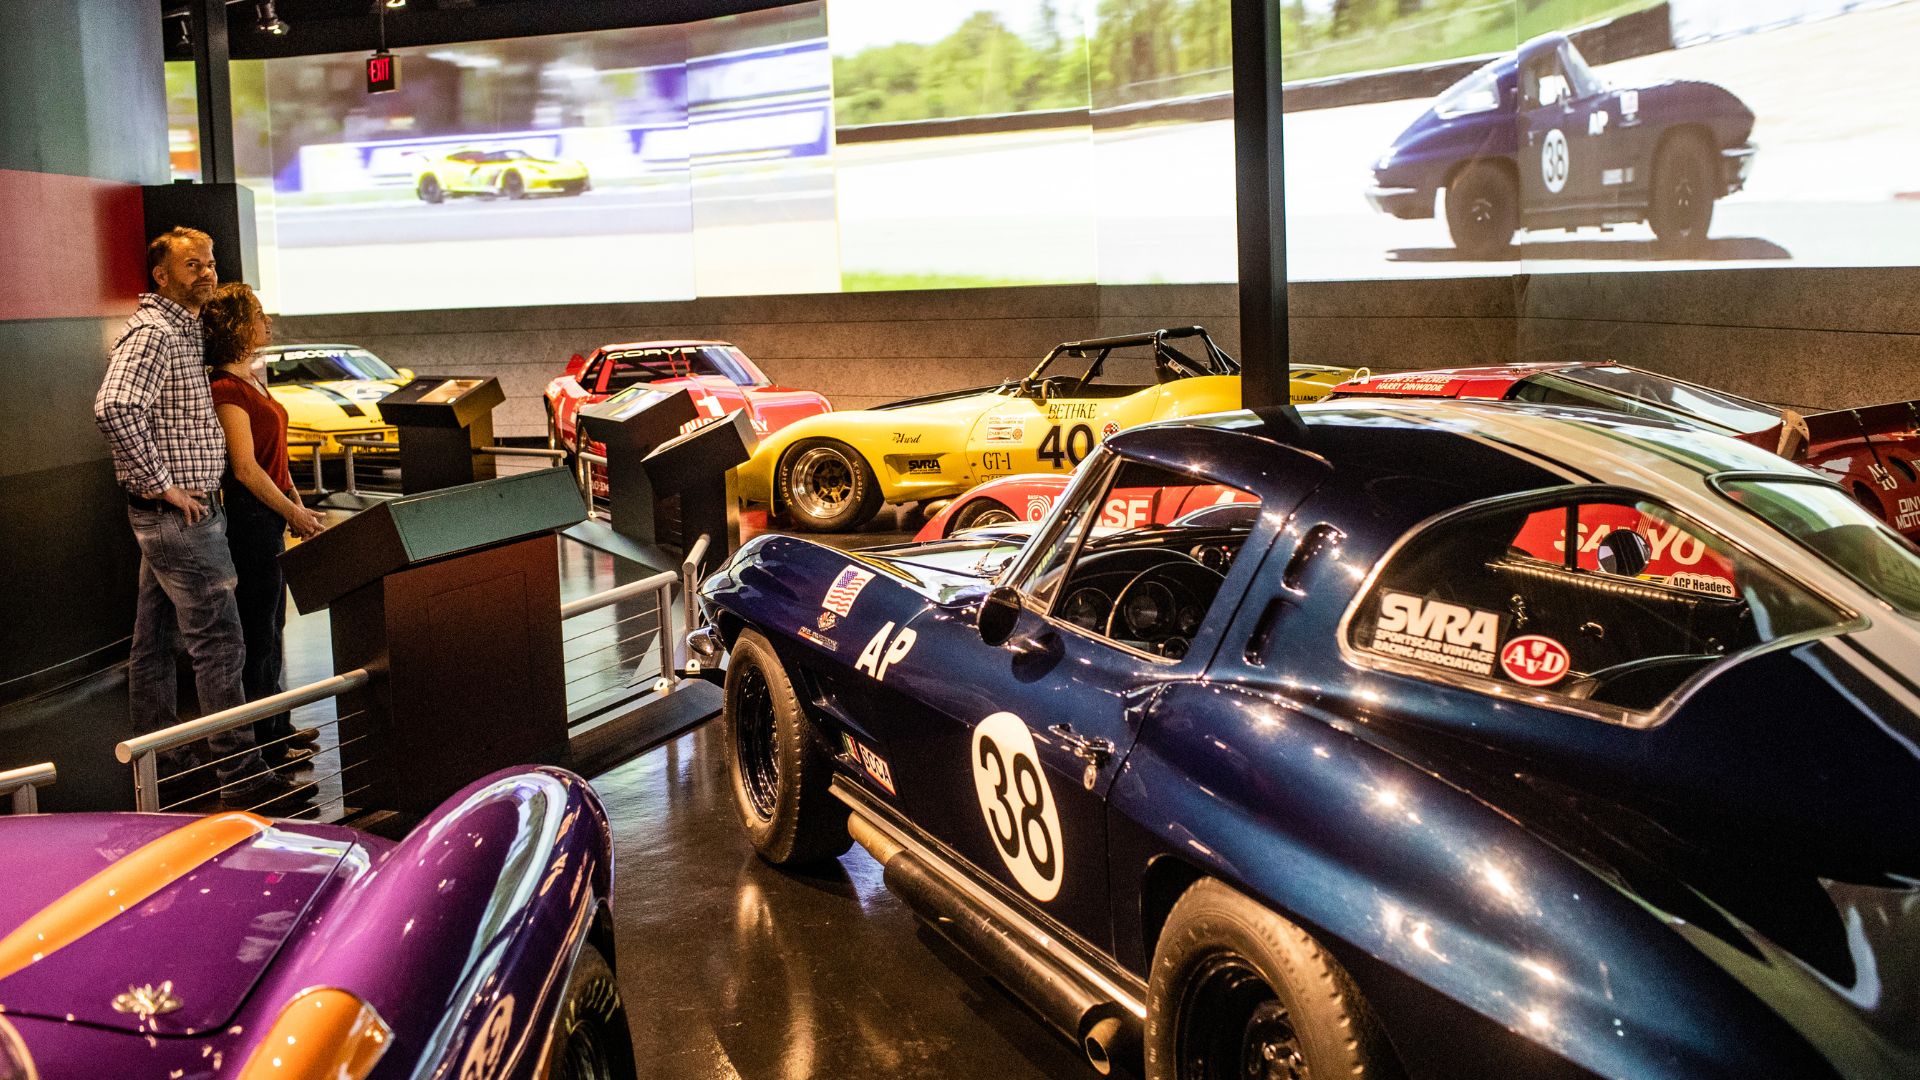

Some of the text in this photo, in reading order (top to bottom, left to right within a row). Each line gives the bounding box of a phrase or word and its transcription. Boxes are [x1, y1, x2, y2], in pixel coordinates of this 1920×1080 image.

[371, 57, 390, 82] EXIT
[1546, 139, 1565, 182] 38
[1376, 382, 1403, 390] HARRY
[1048, 403, 1097, 419] BETHKE
[1037, 423, 1095, 469] 40
[908, 460, 941, 469] SVRA
[1898, 496, 1920, 513] DIN
[1554, 523, 1706, 565] SAYO
[1673, 577, 1732, 595] ACP Headers
[1378, 592, 1499, 653] SVRA
[855, 620, 918, 681] AP
[1372, 639, 1493, 675] RACING ASSOCIATION
[1375, 628, 1496, 664] SPORTSCAR VINTAGE
[979, 735, 1055, 881] 38
